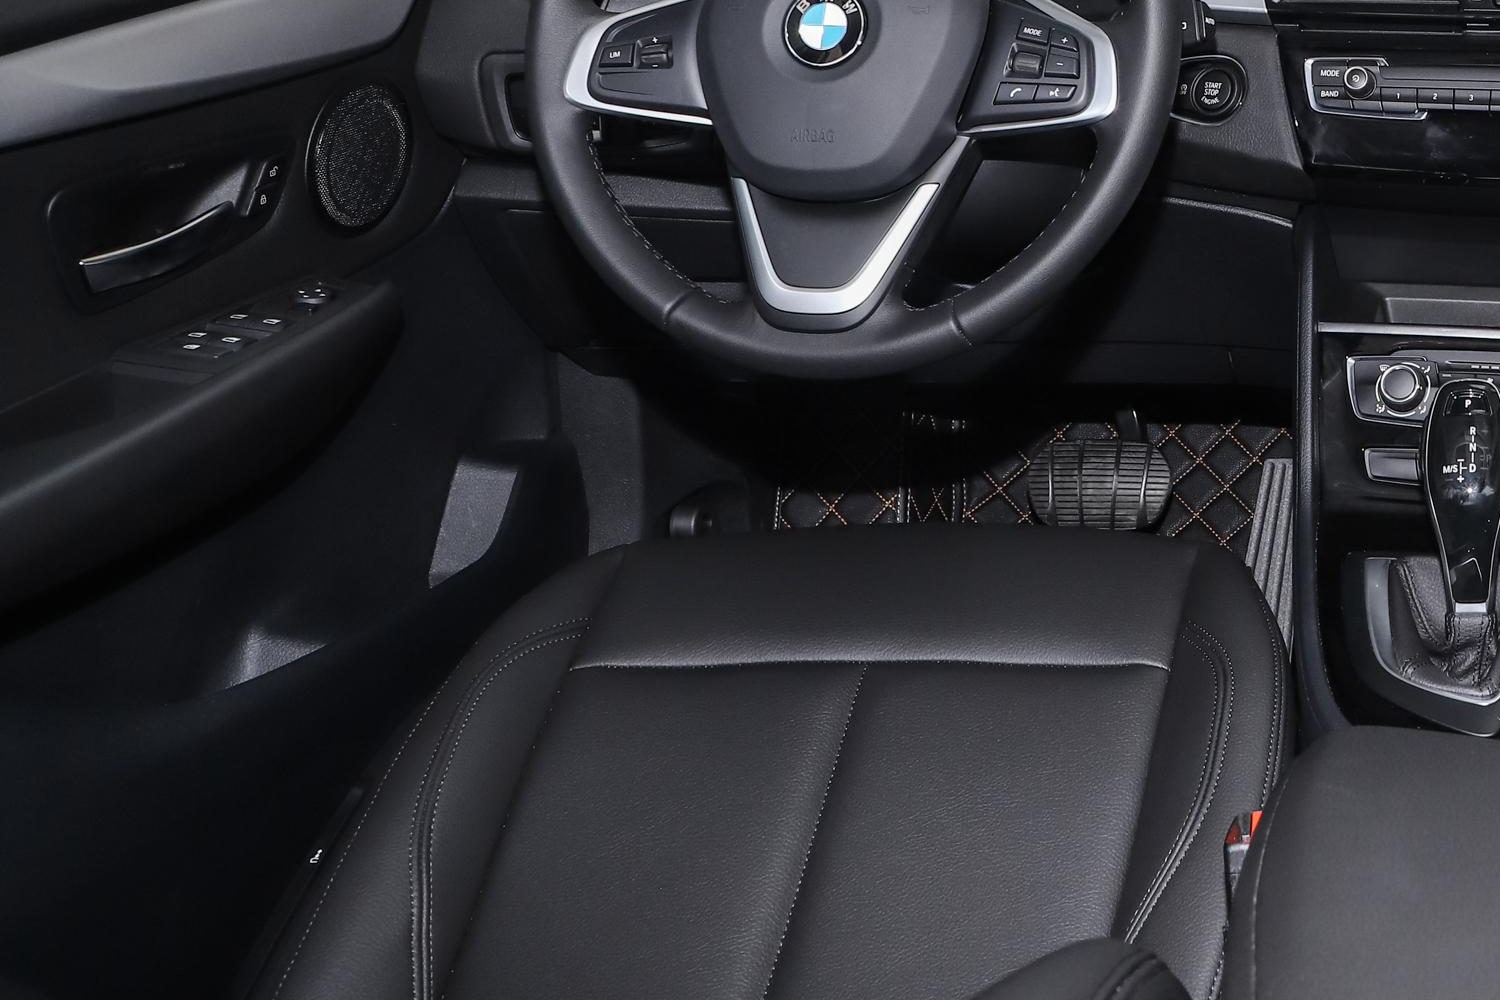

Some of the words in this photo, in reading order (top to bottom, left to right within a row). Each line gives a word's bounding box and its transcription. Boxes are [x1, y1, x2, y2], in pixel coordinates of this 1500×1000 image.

[1023, 27, 1043, 37] MODE
[1320, 69, 1340, 77] MODE
[1204, 81, 1222, 89] START
[1320, 90, 1339, 98] BAND
[790, 128, 835, 143] AIRBAG
[1465, 399, 1472, 408] P
[1469, 426, 1476, 435] R
[1469, 443, 1476, 452] N
[1442, 464, 1459, 473] M/S
[1469, 464, 1476, 473] D
